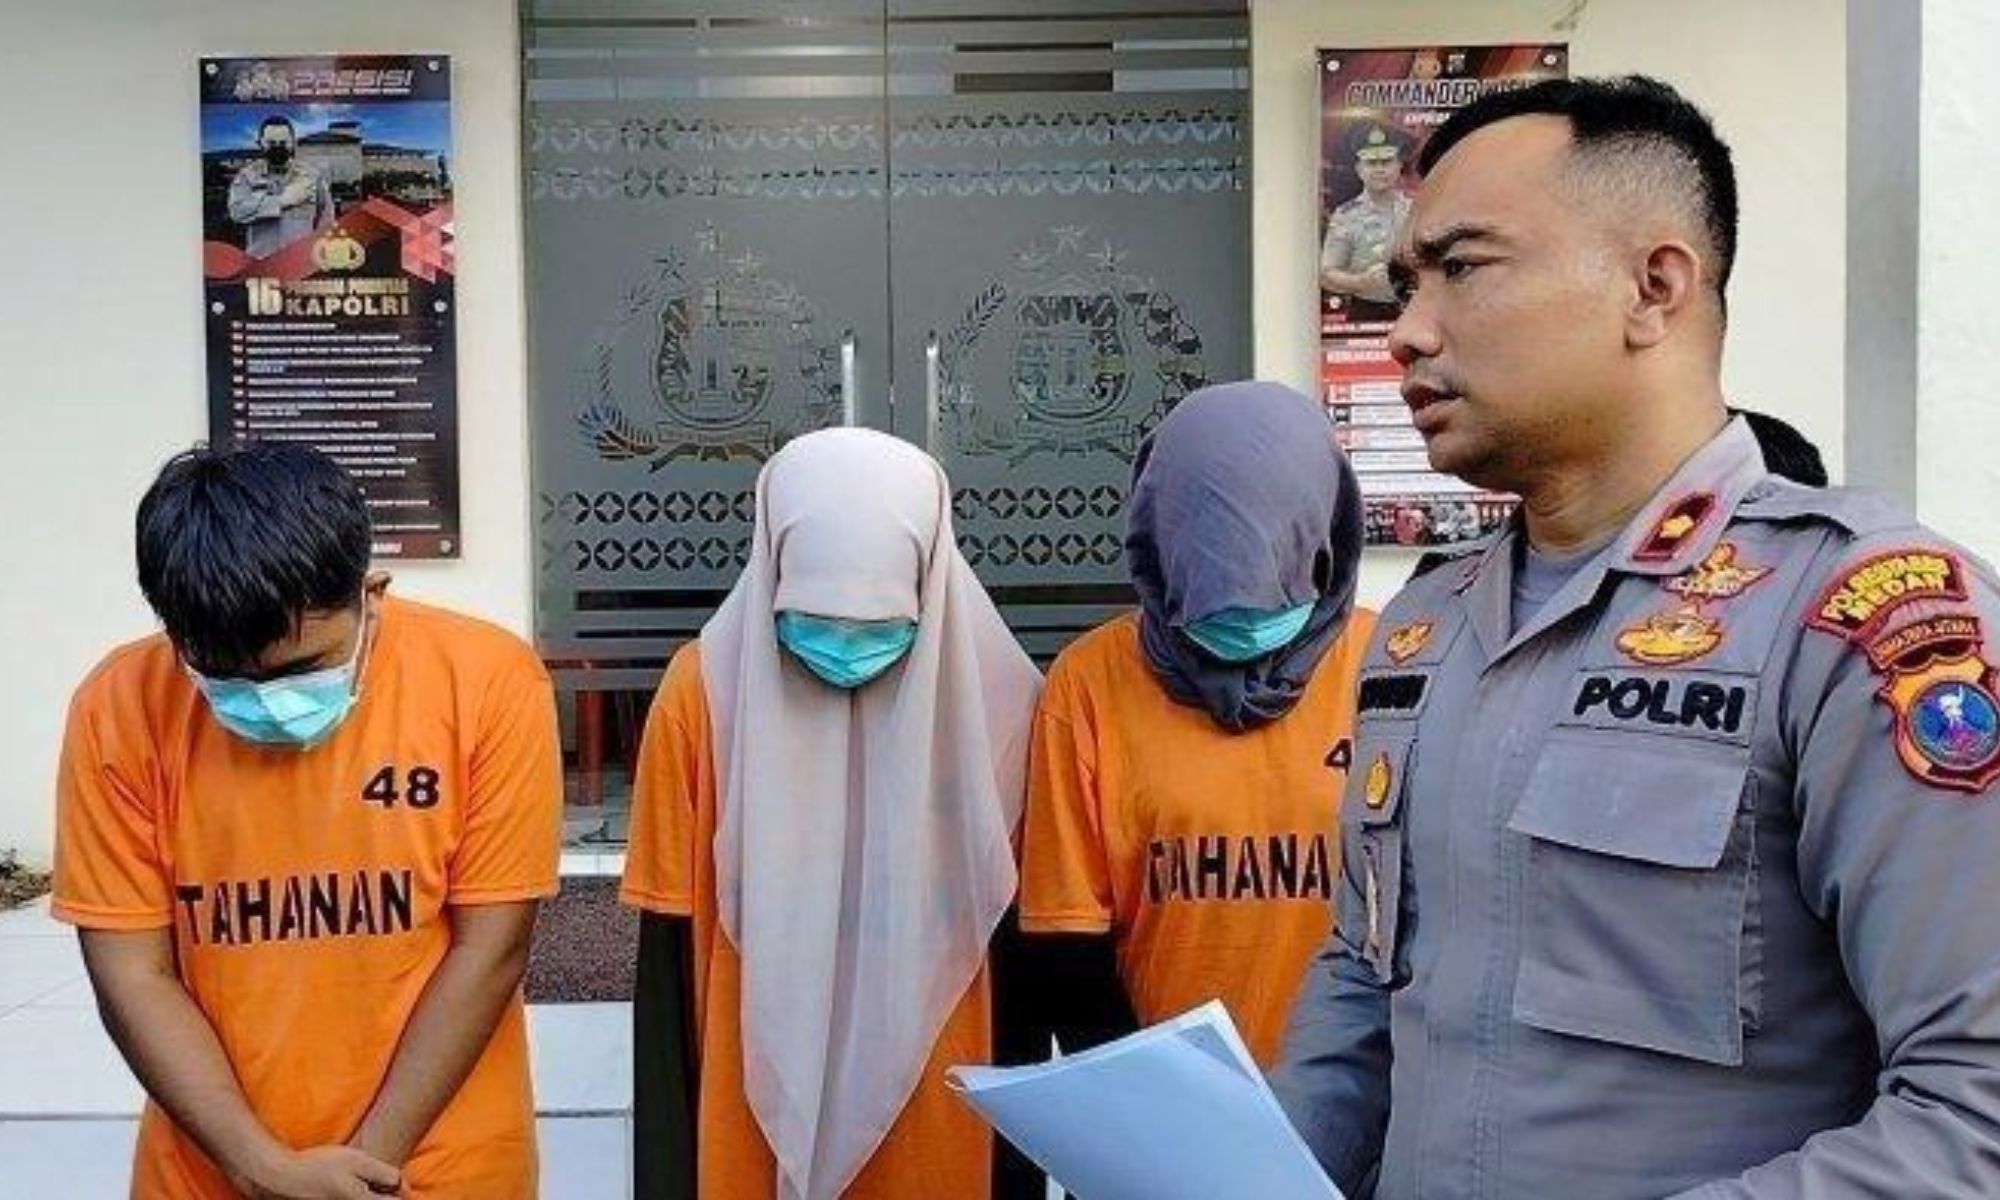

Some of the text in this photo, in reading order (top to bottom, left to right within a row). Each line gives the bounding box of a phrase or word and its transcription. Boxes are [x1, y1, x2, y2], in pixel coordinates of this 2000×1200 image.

[1346, 79, 1481, 108] COMMANDER
[286, 297, 409, 316] KAPOLRI
[1574, 677, 1746, 732] POLRI
[361, 766, 439, 808] 48
[1150, 833, 1331, 902] TAHANA
[175, 870, 411, 944] TAHANAN
